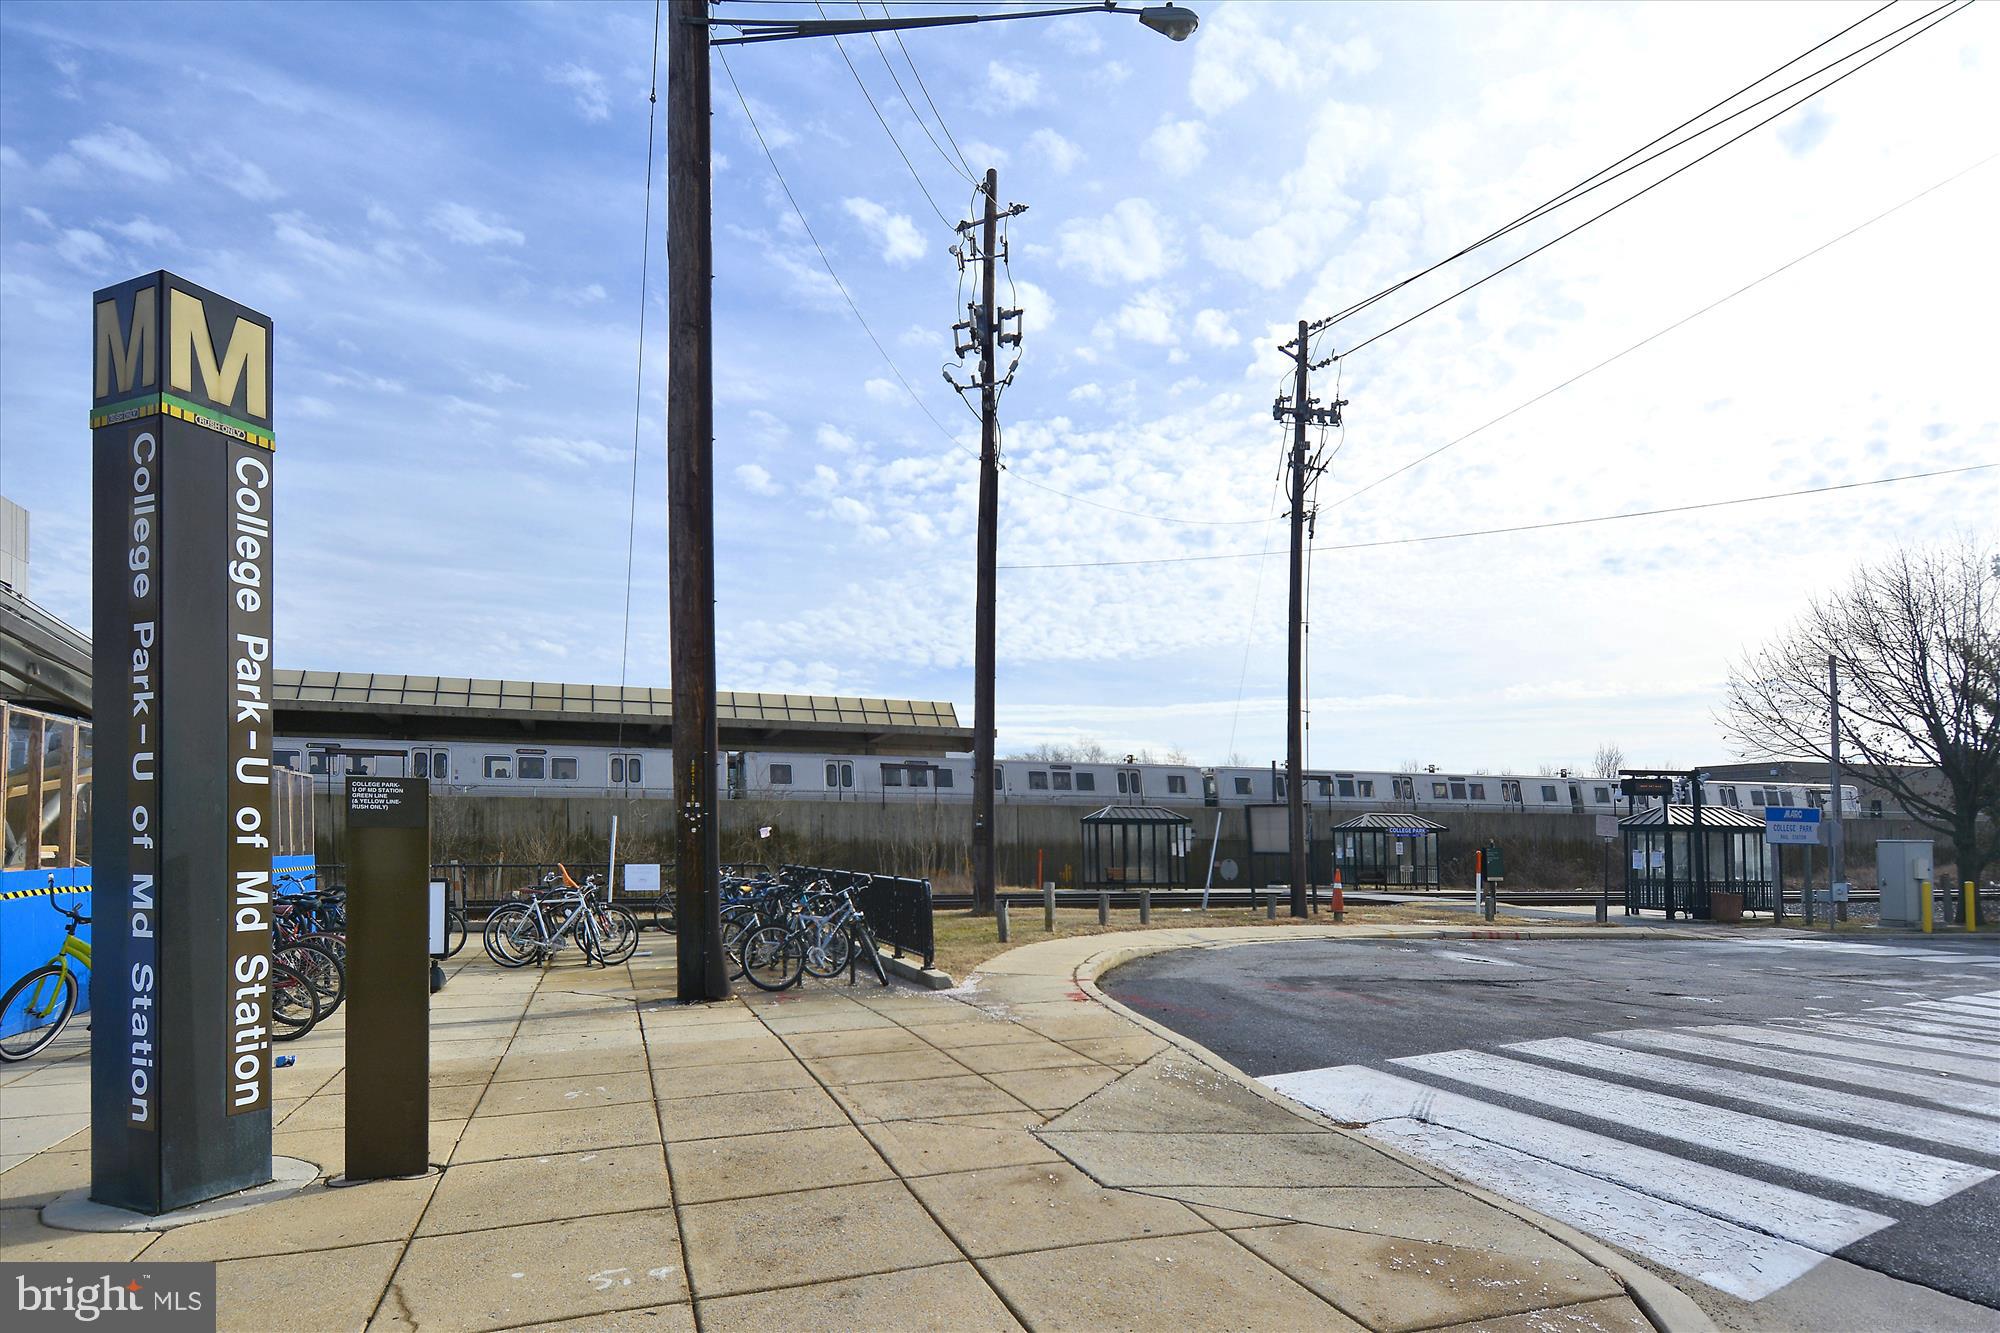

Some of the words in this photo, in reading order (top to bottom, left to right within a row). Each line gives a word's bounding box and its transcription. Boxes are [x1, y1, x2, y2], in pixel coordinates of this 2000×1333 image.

[96, 287, 156, 399] M
[170, 288, 267, 419] M
[200, 416, 220, 431] RUSH
[221, 423, 242, 438] ONLY
[128, 432, 156, 598] College
[228, 456, 269, 613] College
[132, 805, 153, 850] of
[235, 806, 269, 849] of
[1773, 824, 1796, 832] COLLEGE
[131, 874, 154, 938] Md
[235, 871, 269, 932] Md
[131, 962, 154, 1123] Station
[235, 954, 269, 1107] Station
